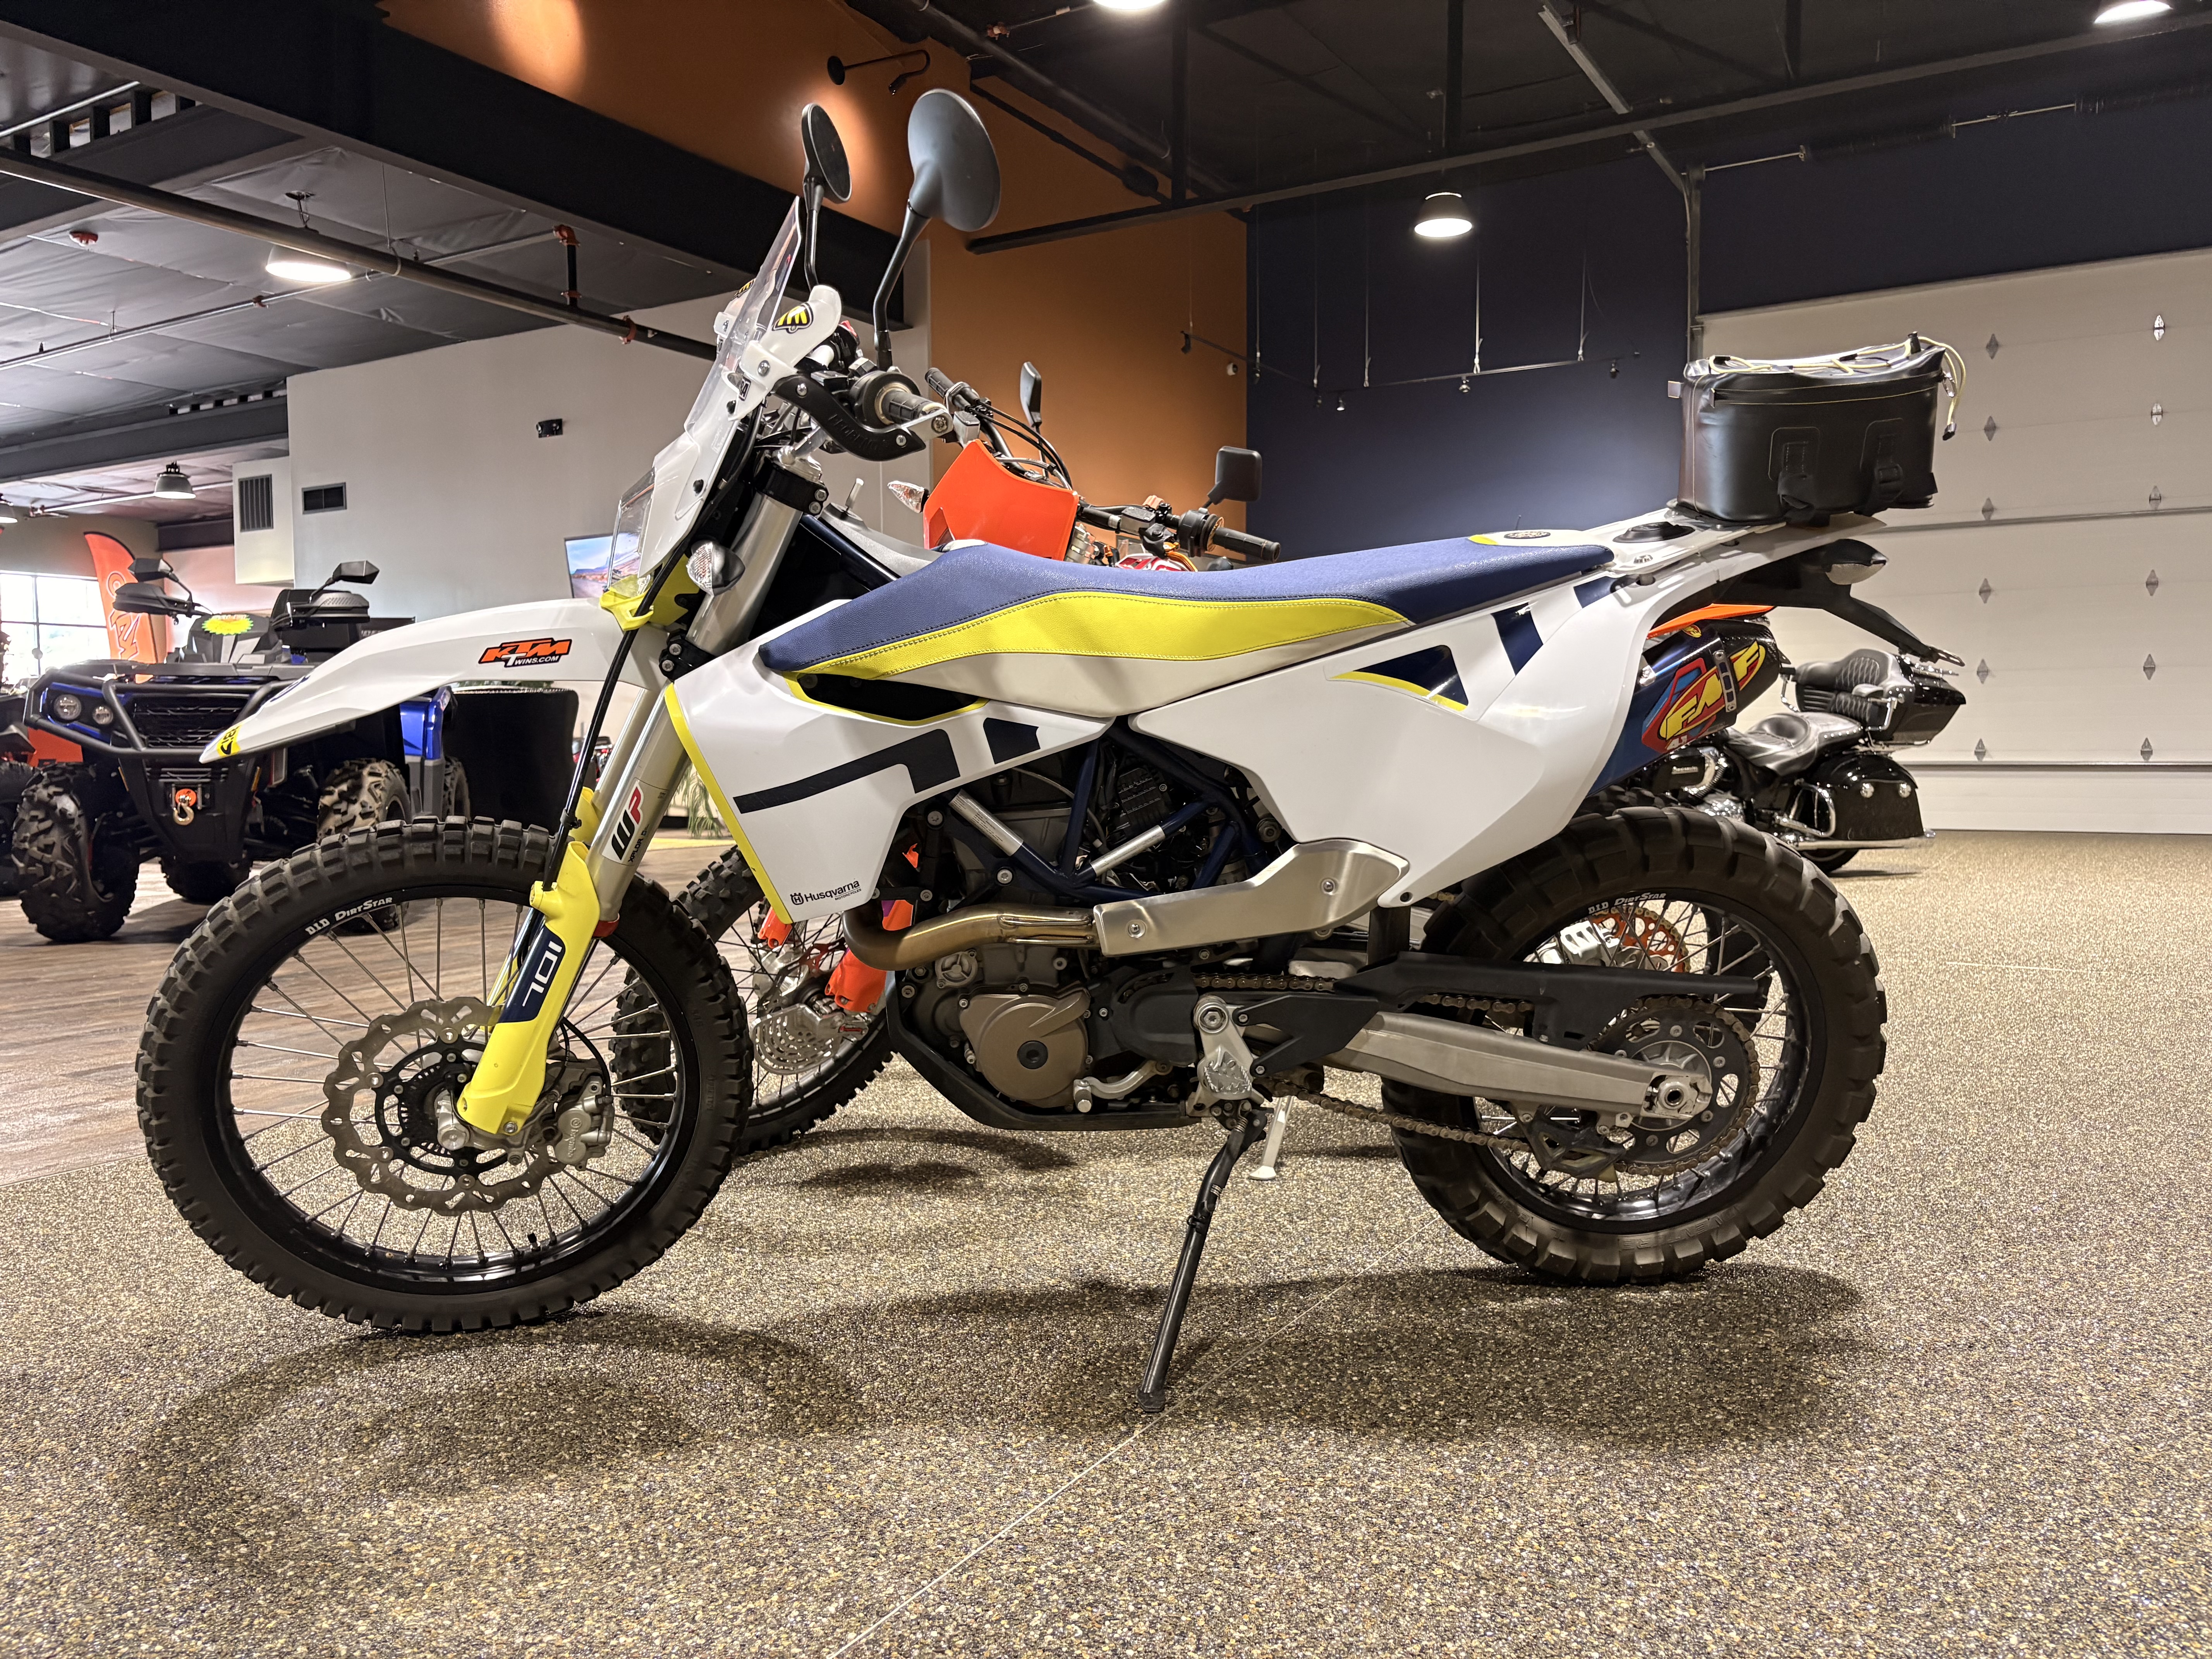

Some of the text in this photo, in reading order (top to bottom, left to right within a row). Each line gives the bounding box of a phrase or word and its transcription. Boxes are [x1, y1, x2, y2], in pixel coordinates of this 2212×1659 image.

[481, 639, 570, 662] KTM
[611, 786, 641, 860] WP
[628, 838, 644, 862] XPLOR
[804, 881, 860, 902] Husqvarna
[835, 889, 862, 900] MOTORCYCLES
[522, 941, 562, 1007] 701
